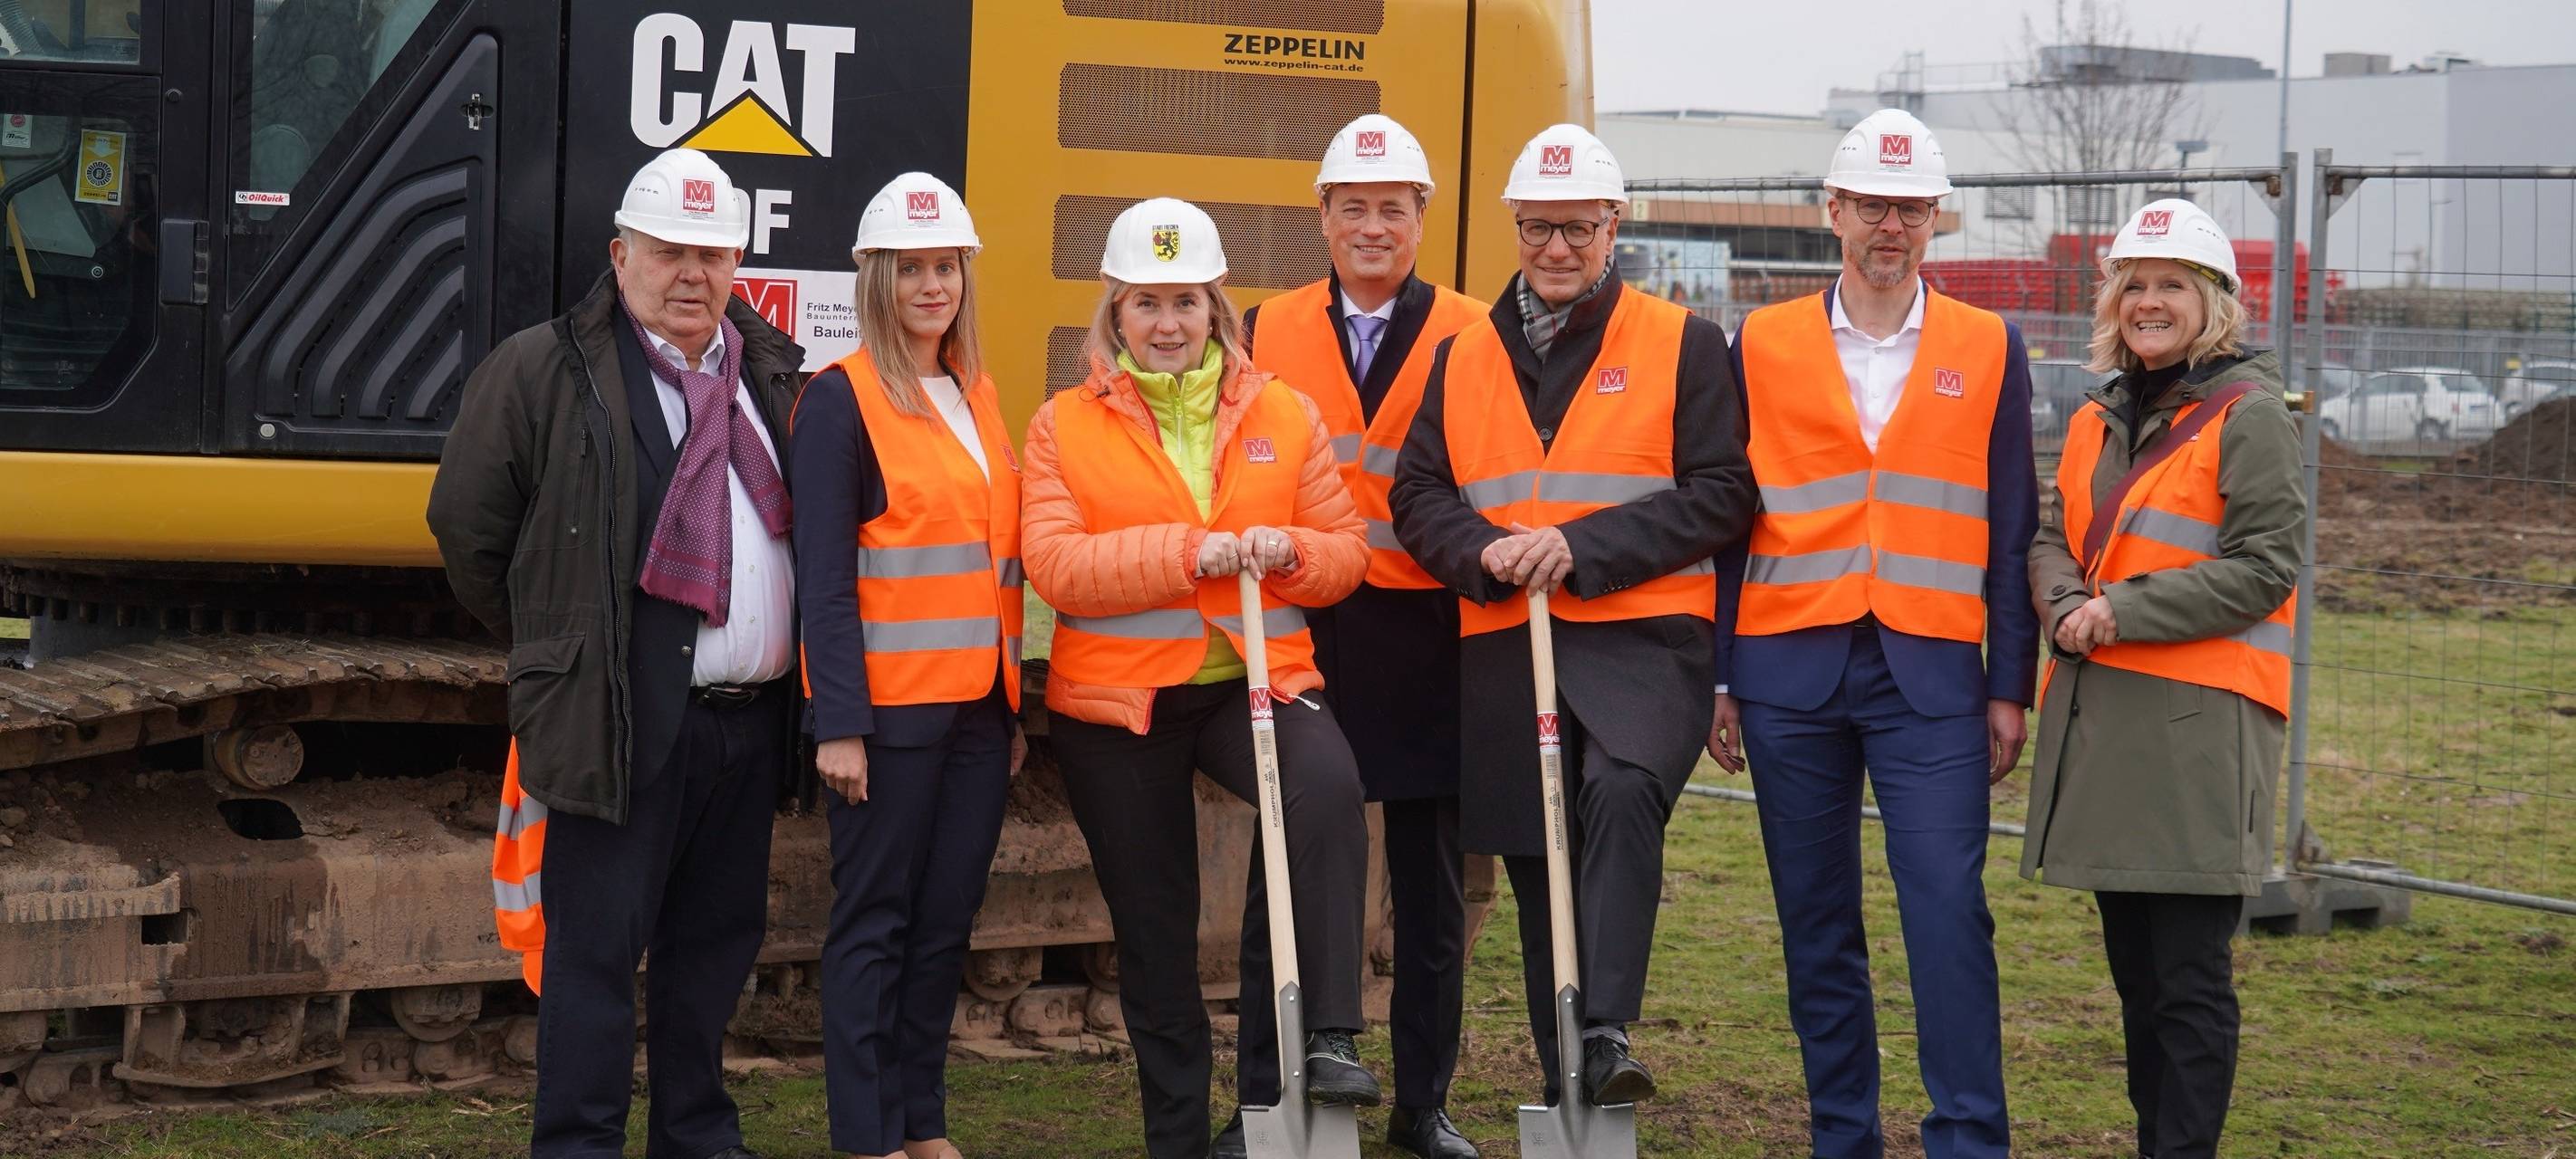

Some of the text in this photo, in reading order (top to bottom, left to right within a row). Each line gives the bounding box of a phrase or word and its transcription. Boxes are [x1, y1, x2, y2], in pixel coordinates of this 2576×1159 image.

[1225, 34, 1365, 60] ZEPPELIN
[1224, 59, 1364, 72] www.zeppelin-cat.de
[630, 13, 856, 158] CAT
[1357, 132, 1385, 149] M
[1880, 135, 1911, 156] M
[1541, 146, 1573, 167] M
[1880, 155, 1911, 164] meyer
[1540, 166, 1572, 174] meyer
[248, 194, 284, 203] OilQuick
[684, 180, 714, 203] M
[684, 201, 714, 210] meyer
[908, 192, 938, 211] M
[2139, 210, 2173, 228] M
[806, 312, 857, 321] Bauunter
[807, 302, 857, 315] Fritz Mey
[813, 326, 860, 339] Baulei
[1598, 368, 1627, 387] M
[1935, 369, 1963, 391] M
[1243, 439, 1274, 456] M
